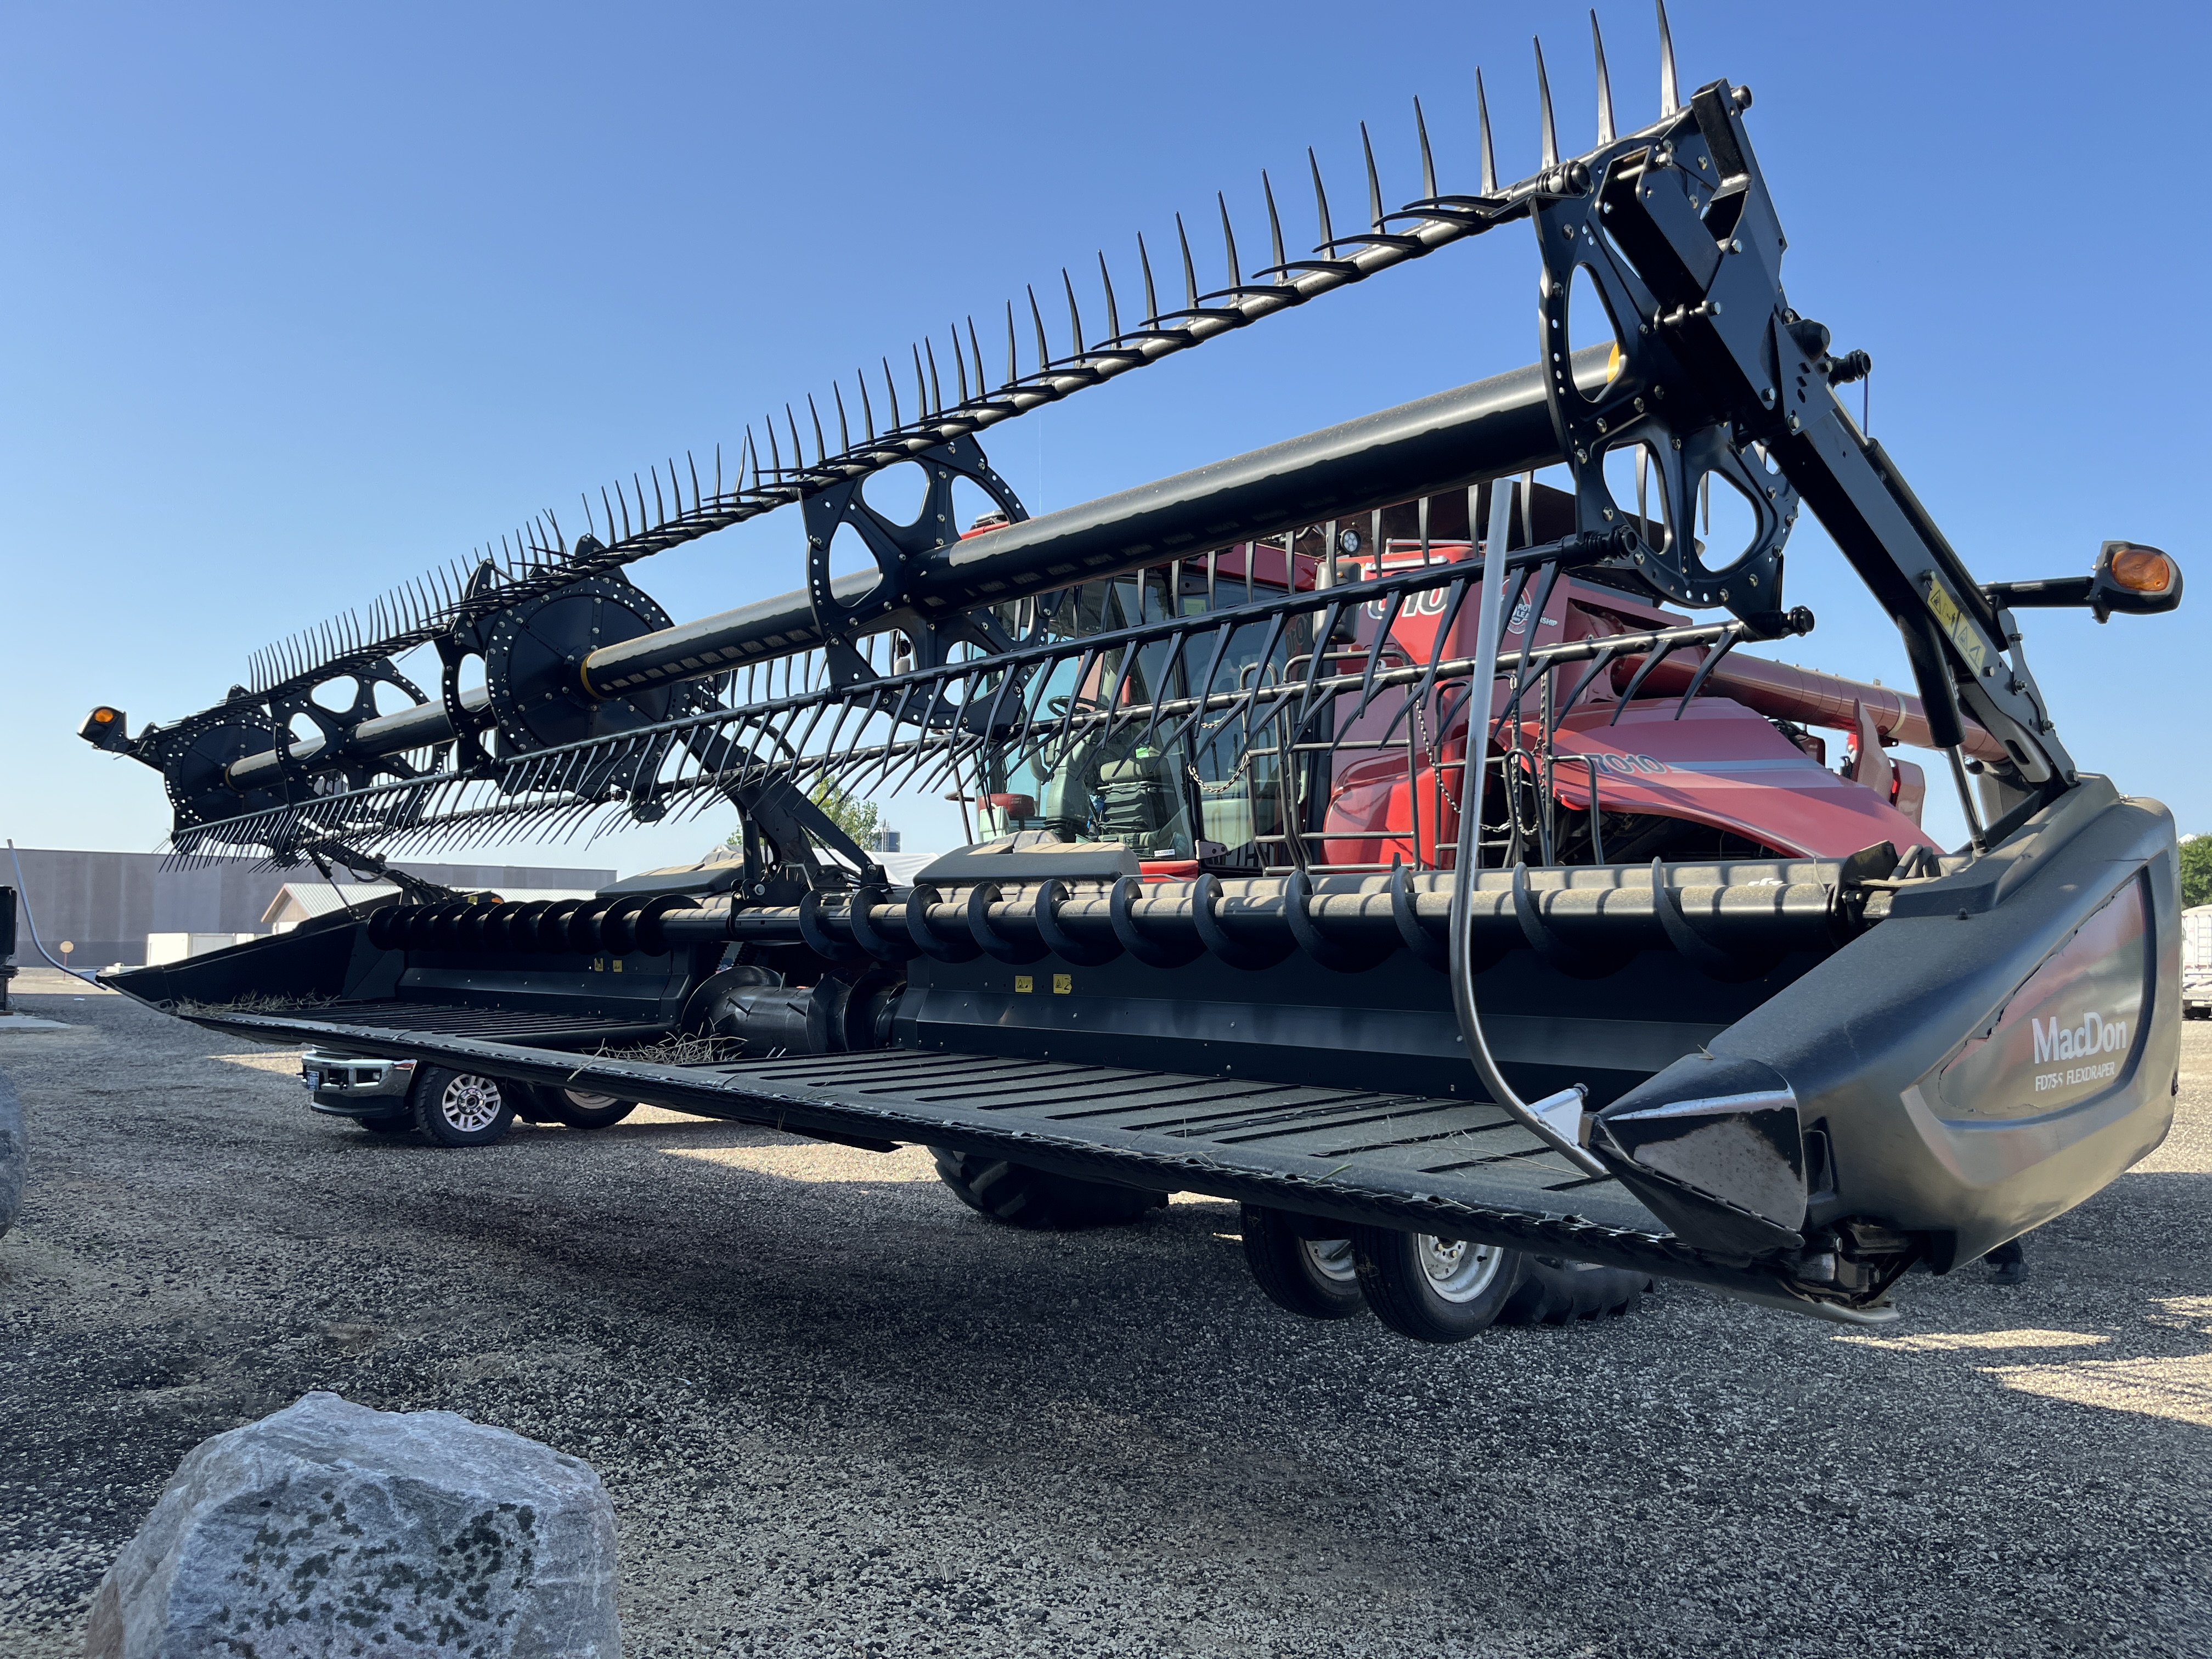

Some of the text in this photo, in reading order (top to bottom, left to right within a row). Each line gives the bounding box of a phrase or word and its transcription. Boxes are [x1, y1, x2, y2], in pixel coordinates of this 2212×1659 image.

[1581, 753, 1667, 774] 7010
[2032, 1012, 2126, 1064] MacDon
[2066, 1062, 2115, 1085] FLEXDRAPER
